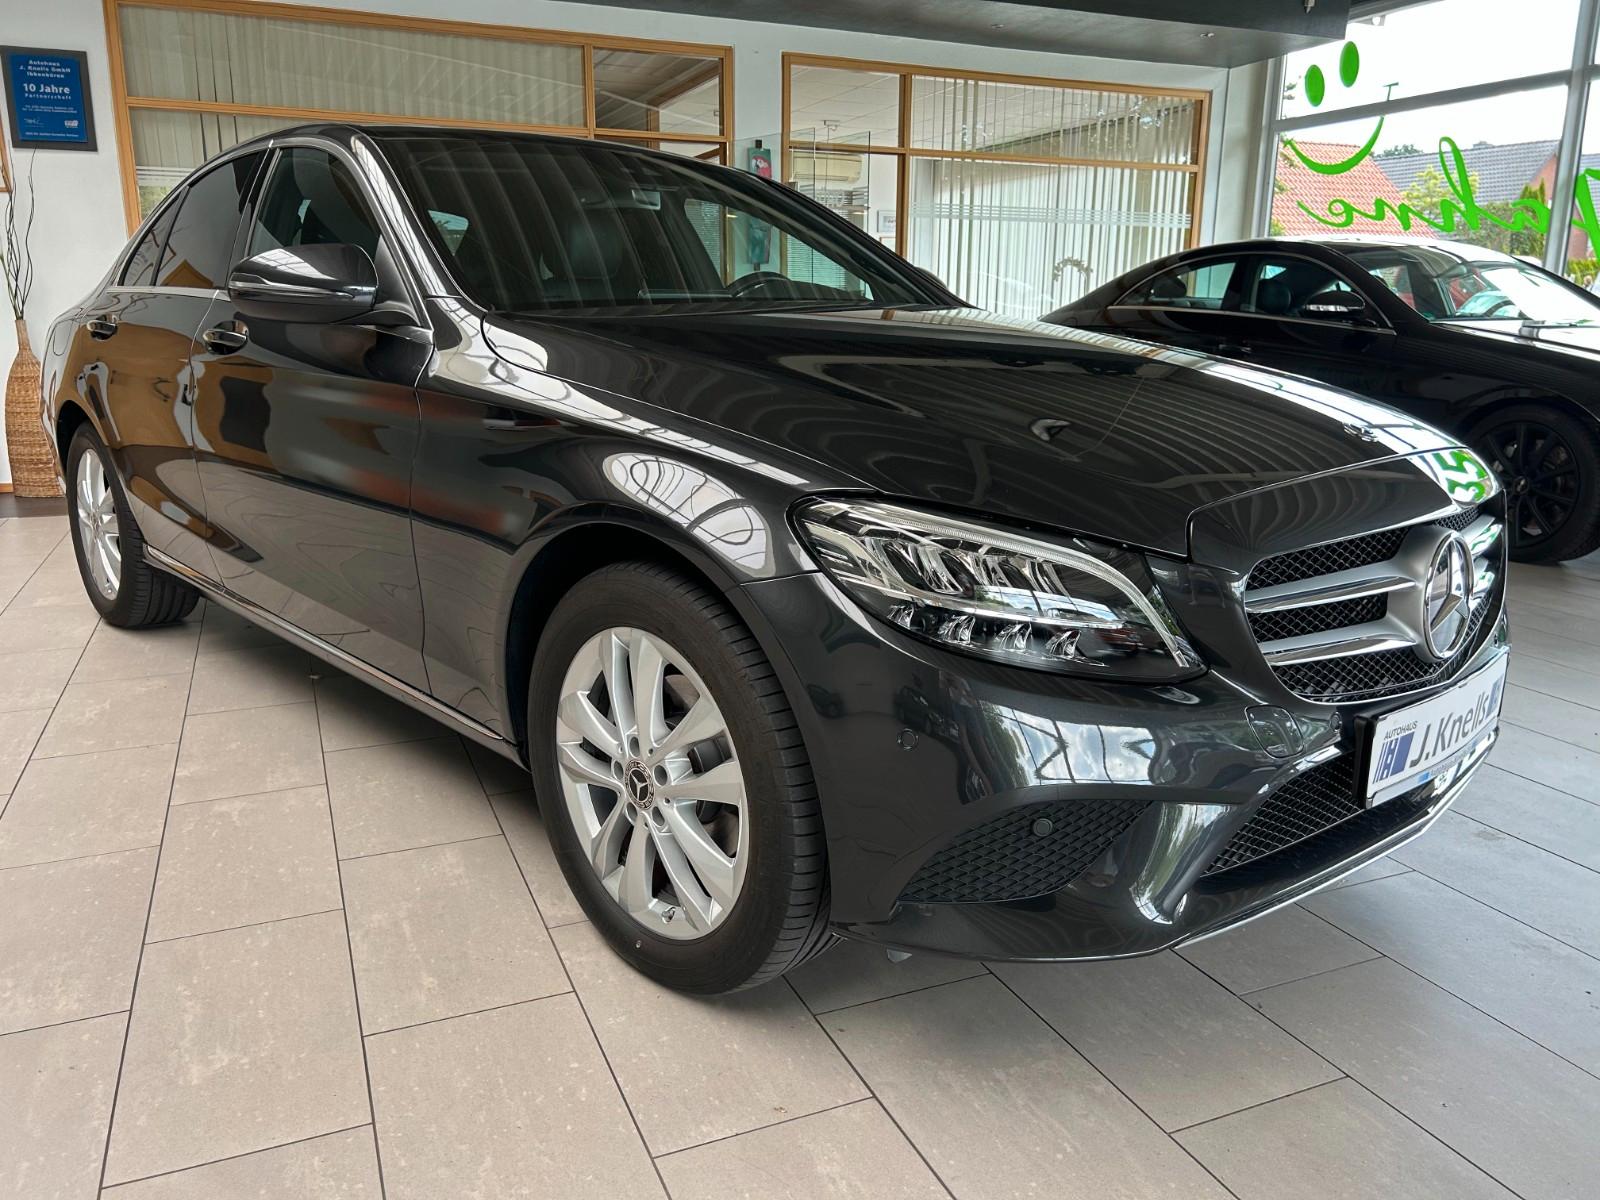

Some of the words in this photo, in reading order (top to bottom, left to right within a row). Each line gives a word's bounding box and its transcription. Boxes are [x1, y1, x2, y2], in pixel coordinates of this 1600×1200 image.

[23, 83, 36, 92] 10
[39, 84, 70, 94] Jahre
[1384, 720, 1418, 740] AUTOHAUS
